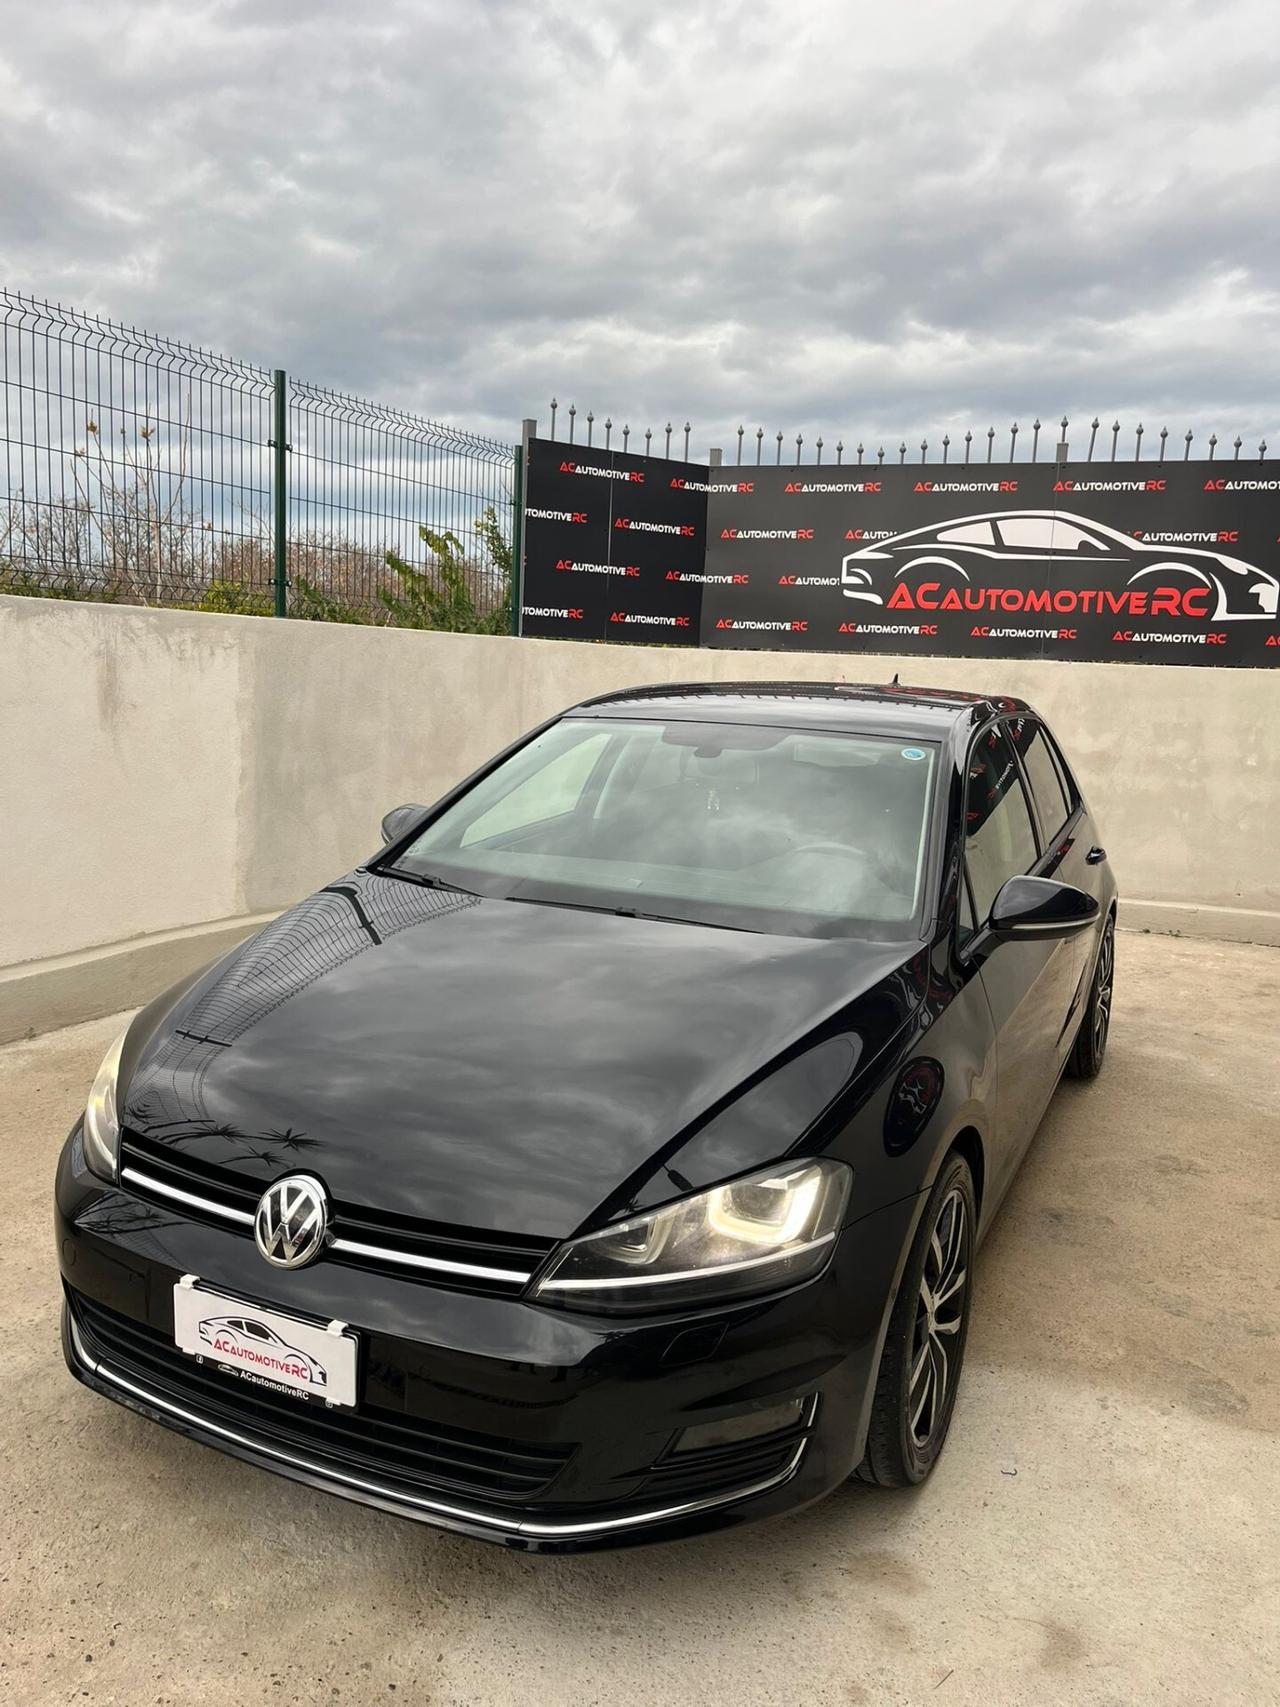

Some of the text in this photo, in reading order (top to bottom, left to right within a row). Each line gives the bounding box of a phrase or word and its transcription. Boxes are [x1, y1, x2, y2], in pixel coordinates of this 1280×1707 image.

[559, 461, 646, 483] ACAUTOMOTIVERC
[670, 478, 755, 494] ACAUTOMOTIVERC
[784, 482, 882, 494] ACAUTOMOTIVERC
[914, 481, 1019, 493] ACAUTOMOTIVERC
[1053, 480, 1167, 492] ACAUTOMOTIVERC
[614, 517, 695, 537] ACAUTOMOTIVERC
[720, 529, 815, 540] ACAUTOMOTIVERC
[555, 559, 641, 577] ACAUTOMOTIVERC
[665, 570, 749, 585] ACAUTOMOTIVERC
[886, 581, 1212, 618] ACAUTOMOTIVERC
[609, 611, 690, 627] ACAUTOMOTIVERC
[716, 618, 809, 632] ACAUTOMOTIVERC
[838, 622, 939, 636] ACAUTOMOTIVERC
[970, 626, 1078, 640] ACAUTOMOTIVERC
[1112, 630, 1228, 645] ACAUTOMOTIVERC
[213, 1338, 308, 1380] ACAUTOMOTIVERC
[240, 1370, 310, 1400] ACautomotiveRC
